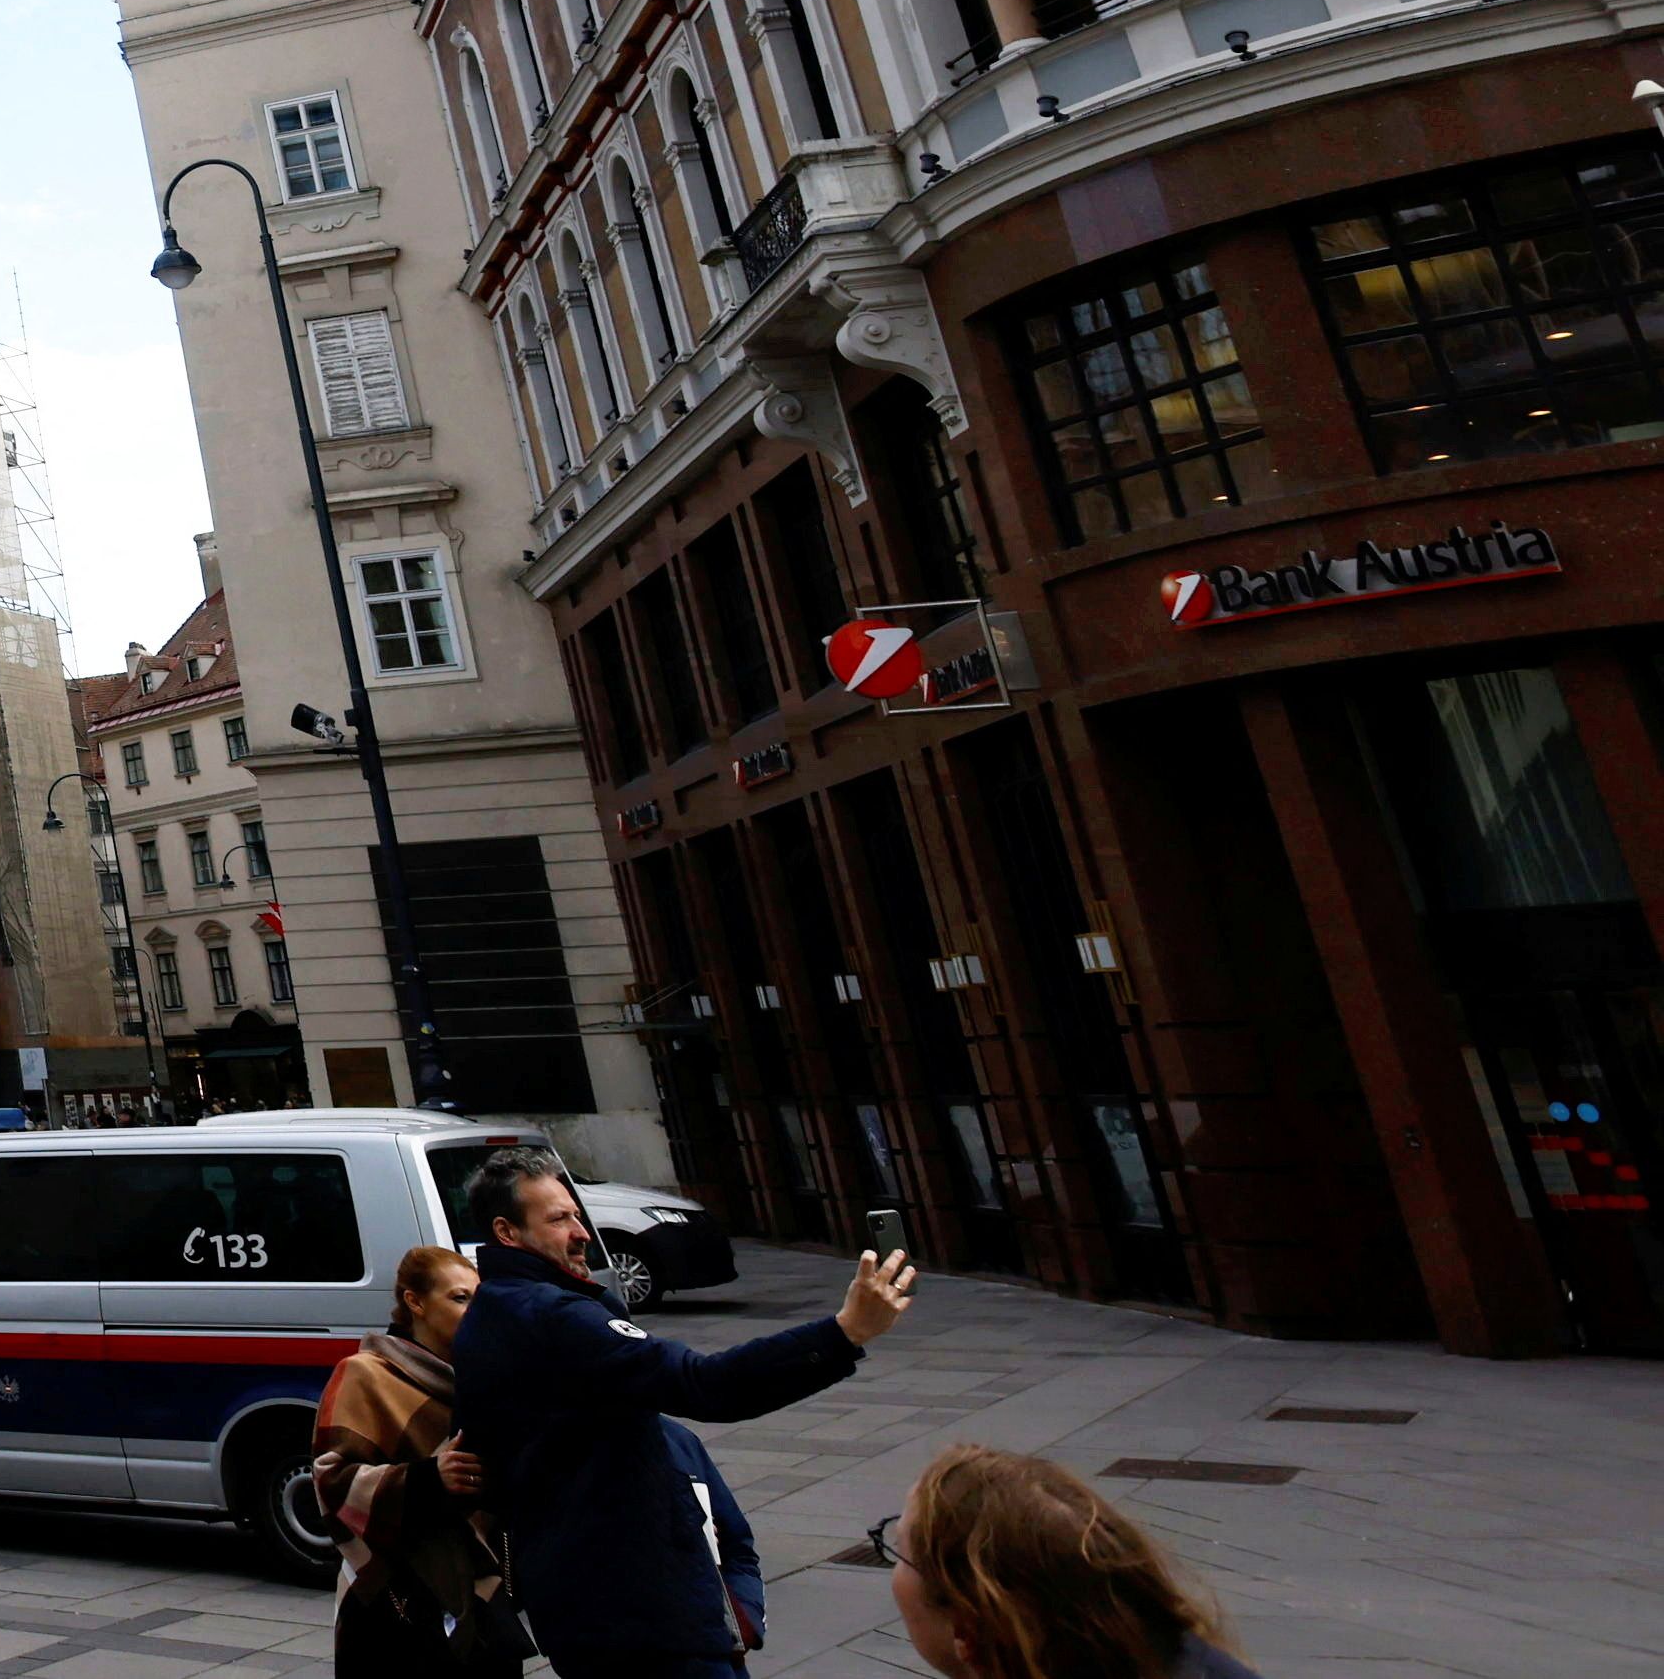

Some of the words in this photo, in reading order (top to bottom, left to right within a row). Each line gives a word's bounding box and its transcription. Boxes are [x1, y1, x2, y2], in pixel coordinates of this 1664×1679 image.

[1210, 551, 1343, 612] Bank
[1357, 520, 1557, 589] Austria
[209, 1234, 268, 1268] 133
